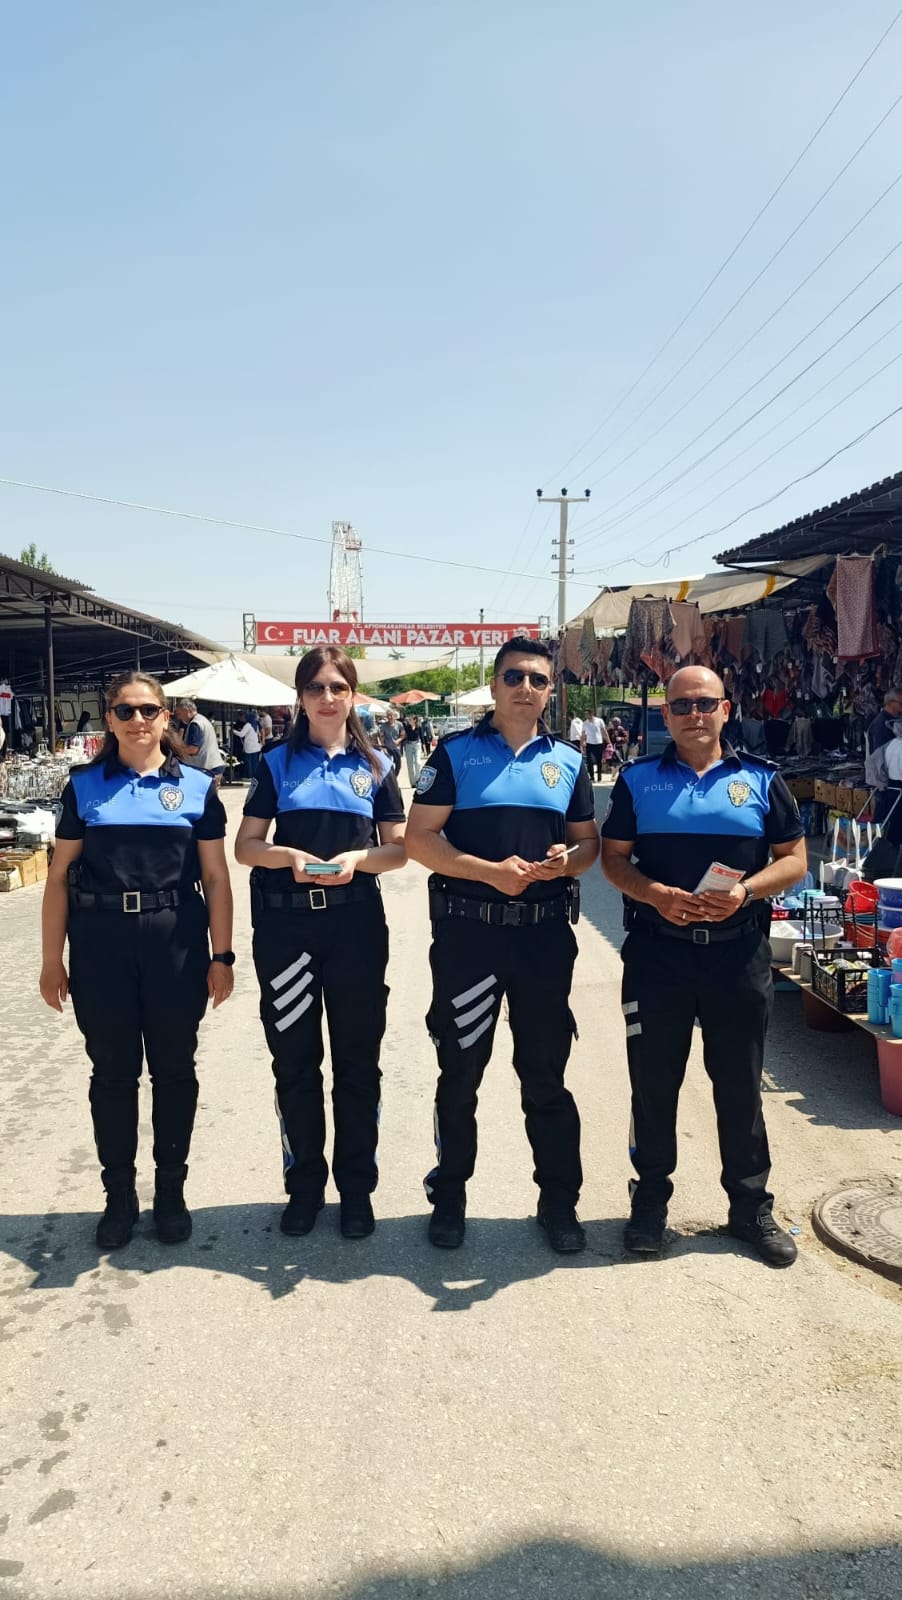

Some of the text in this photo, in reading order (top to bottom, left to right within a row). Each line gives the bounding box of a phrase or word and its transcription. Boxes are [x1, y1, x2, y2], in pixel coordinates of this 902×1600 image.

[293, 628, 340, 645] FUAR
[345, 629, 401, 646] ALANI
[406, 630, 465, 646] PAZAR
[644, 781, 674, 793] POLİS
